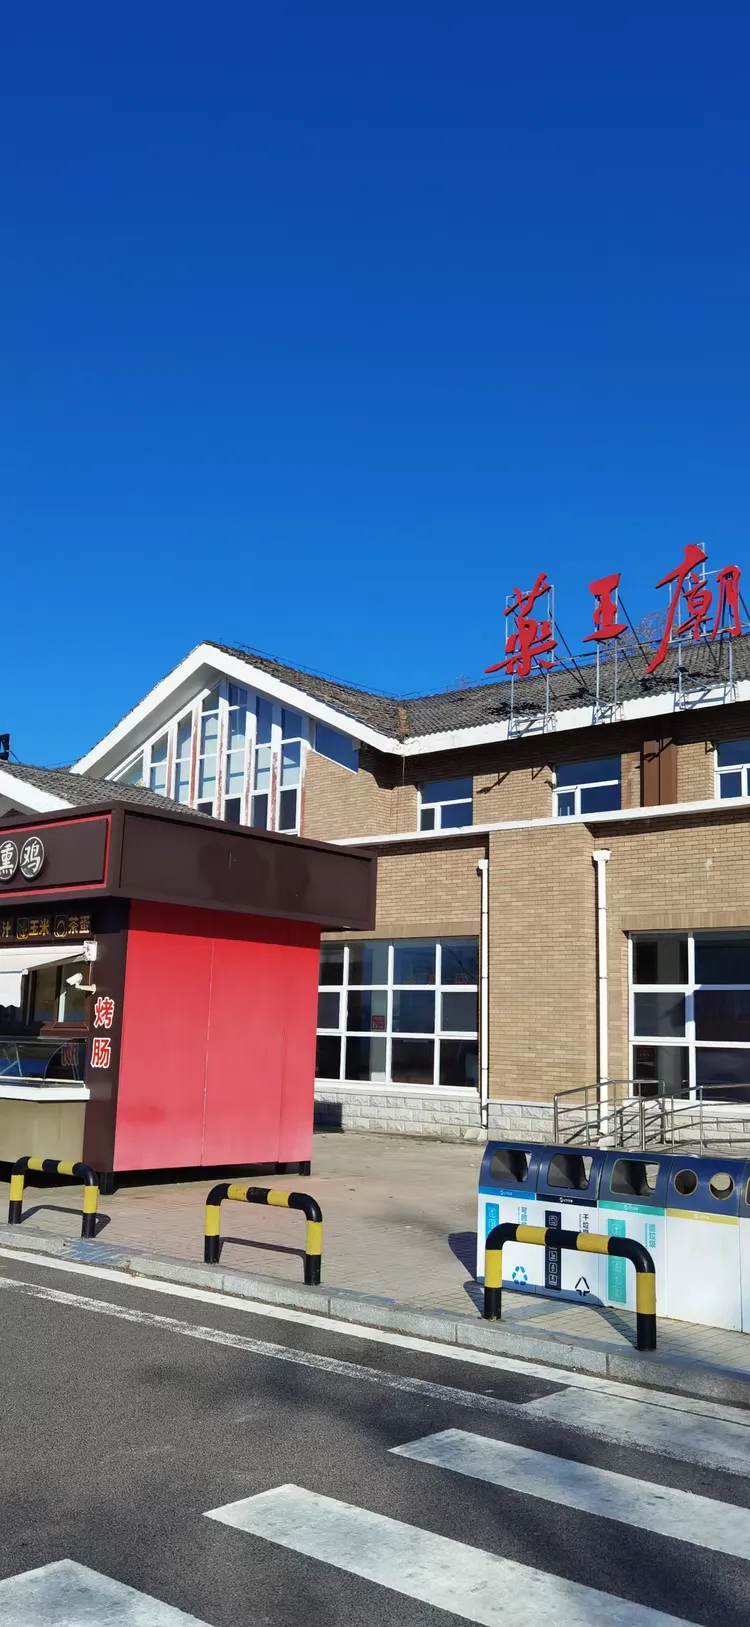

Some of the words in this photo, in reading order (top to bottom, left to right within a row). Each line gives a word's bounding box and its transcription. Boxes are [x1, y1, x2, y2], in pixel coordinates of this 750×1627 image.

[28, 918, 50, 936] 玉米
[68, 915, 91, 934] 茶蛋
[90, 996, 115, 1069] 烤肠
